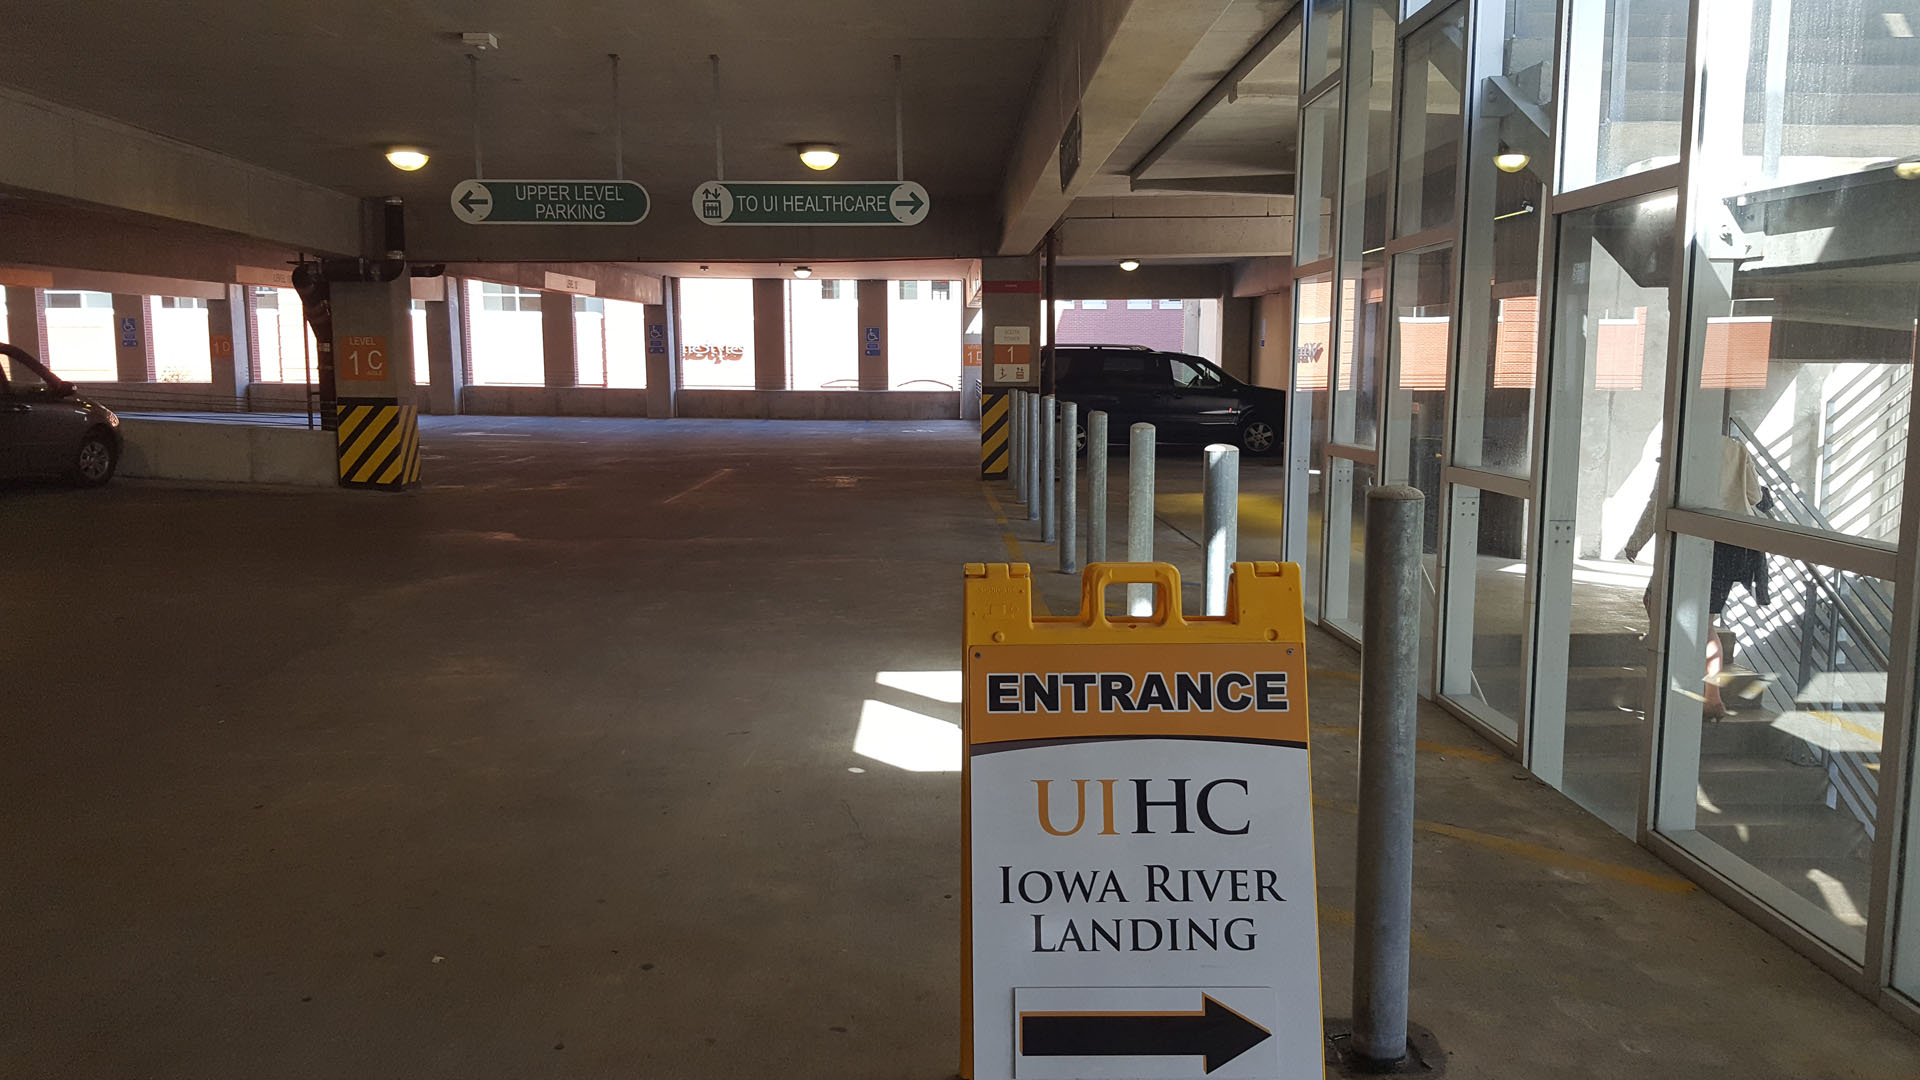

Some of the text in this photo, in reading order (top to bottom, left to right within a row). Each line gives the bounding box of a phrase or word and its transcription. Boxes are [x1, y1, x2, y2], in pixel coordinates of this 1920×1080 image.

[515, 185, 624, 201] UPPER LEVEL
[736, 195, 887, 212] TO UI HEALTHCARE
[535, 204, 606, 220] PARKING
[350, 336, 377, 345] LEVEL
[349, 350, 382, 375] 1 C
[1008, 346, 1014, 363] 1
[986, 672, 1290, 713] ENTRANCE
[1030, 778, 1251, 836] UIHC
[999, 865, 1288, 904] IOWA RIVER
[1030, 914, 1258, 953] LANDING
